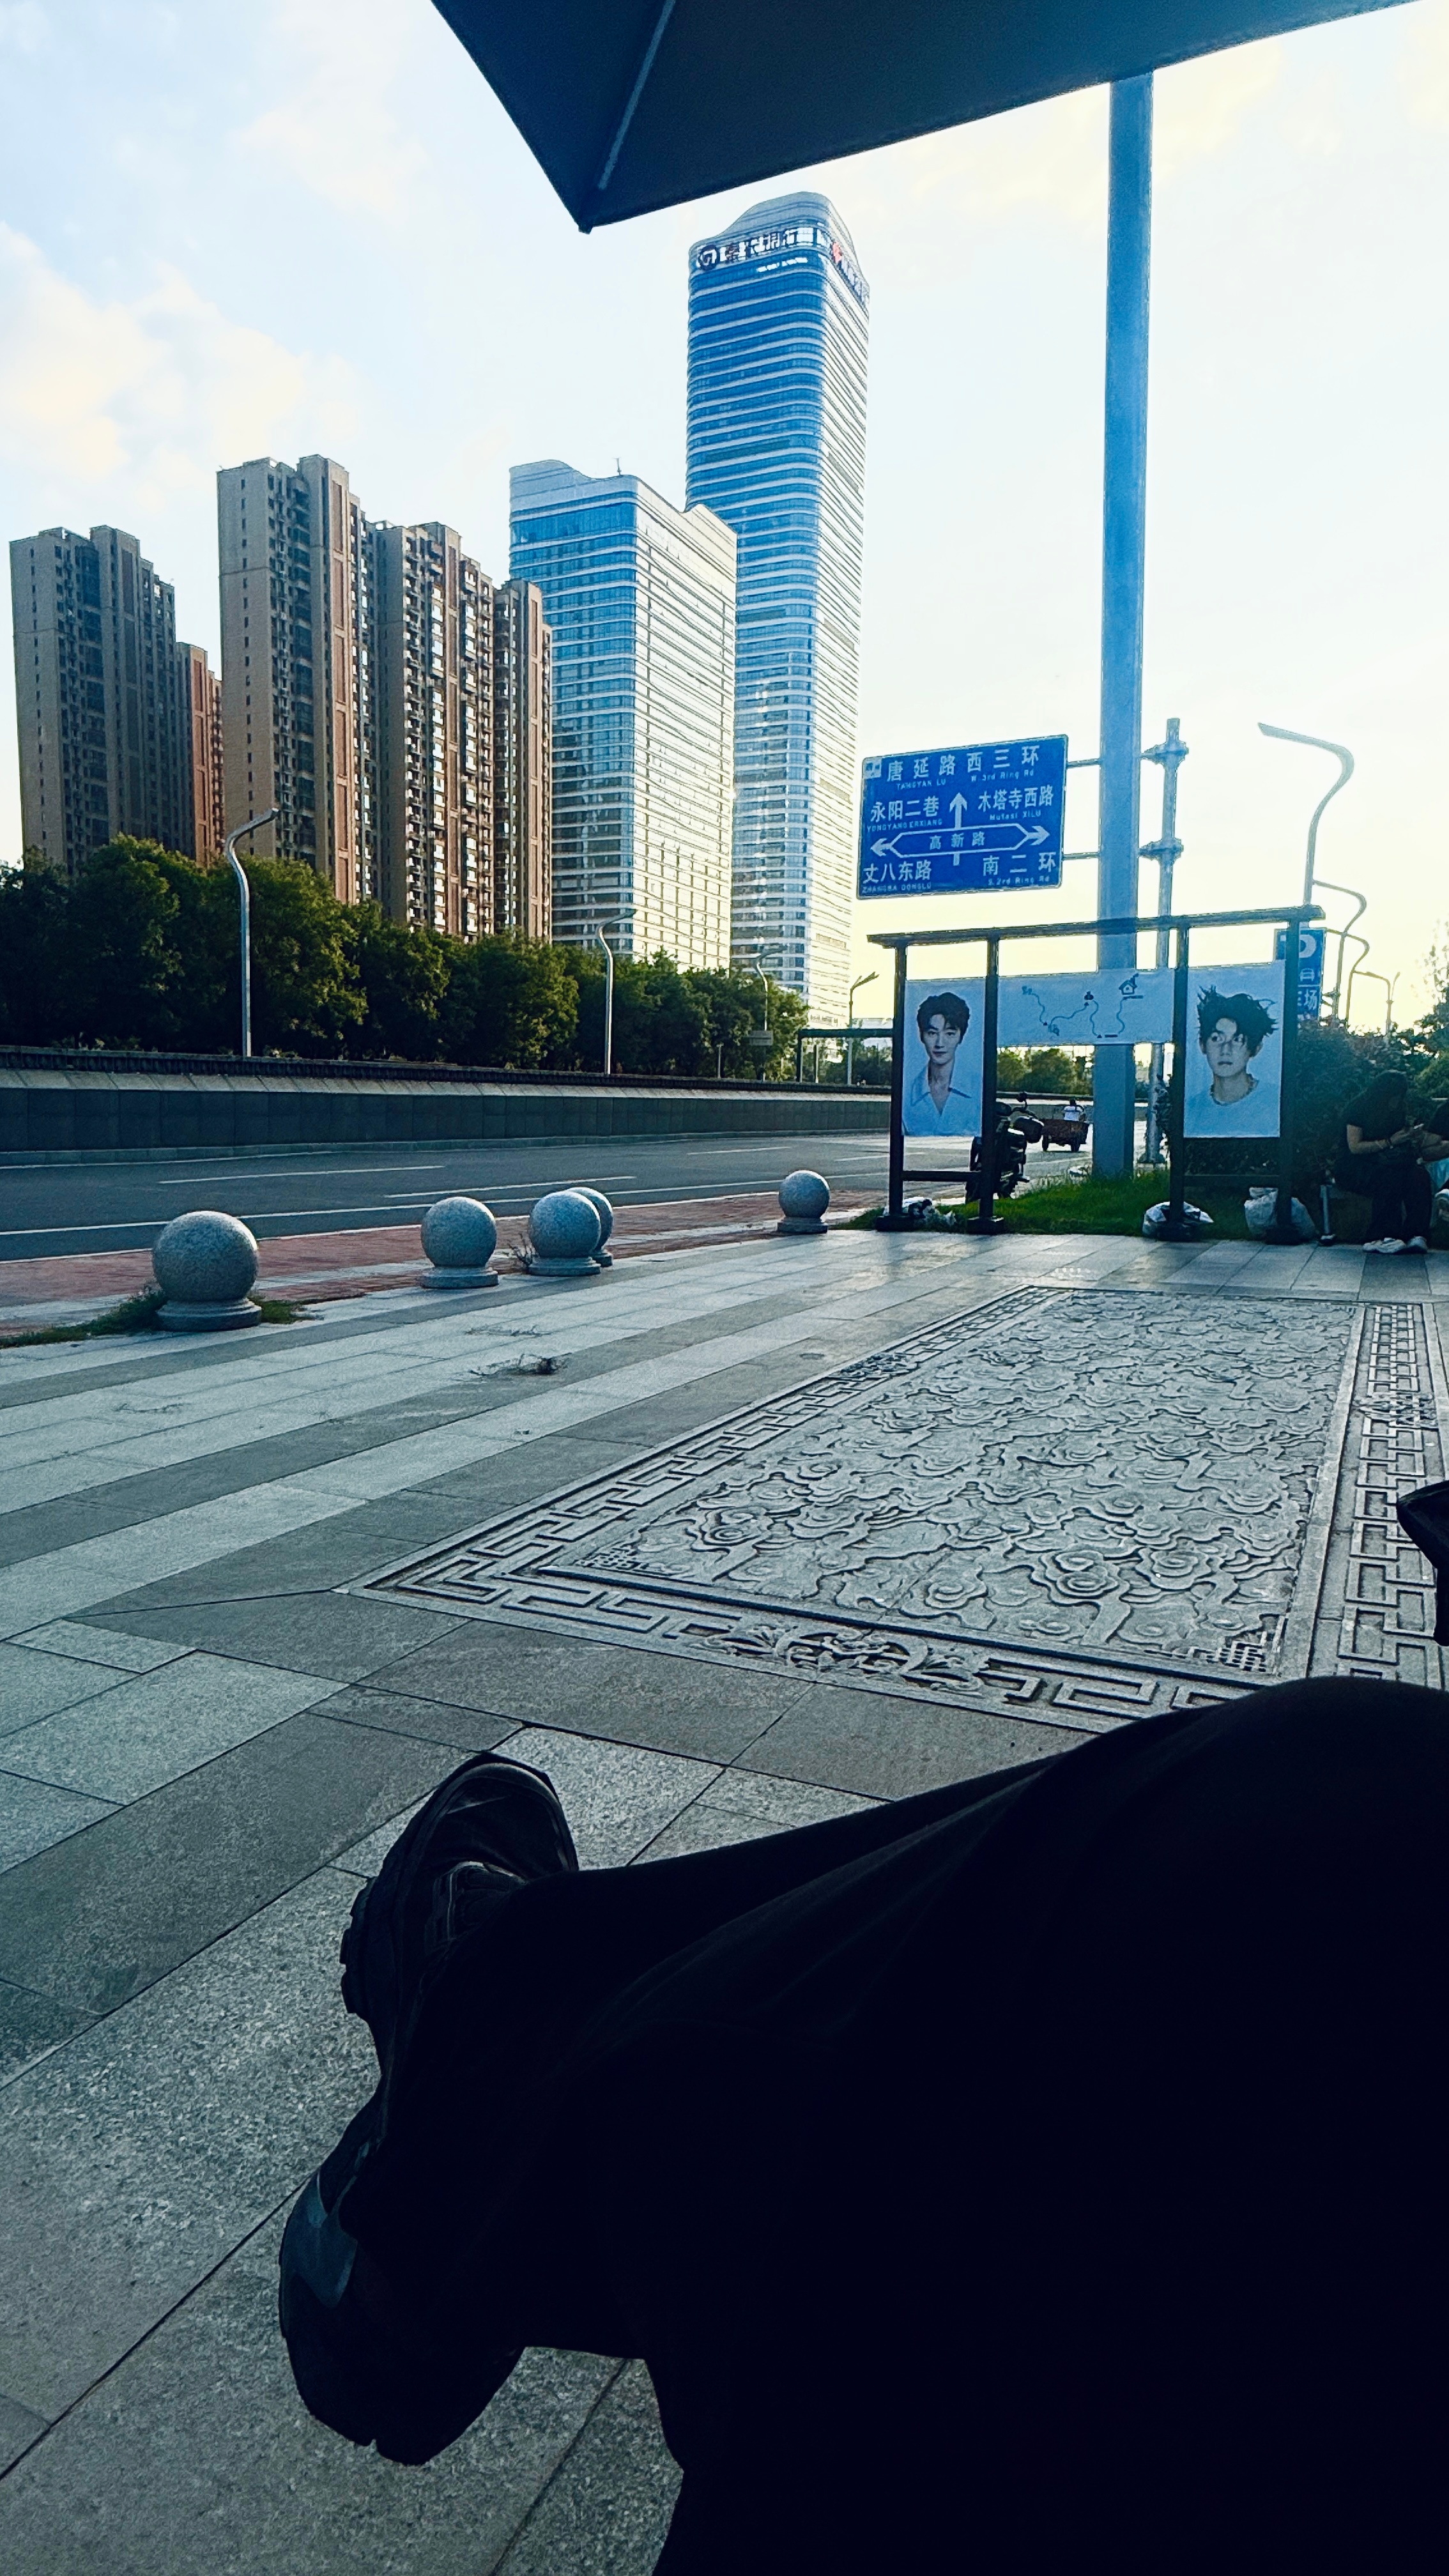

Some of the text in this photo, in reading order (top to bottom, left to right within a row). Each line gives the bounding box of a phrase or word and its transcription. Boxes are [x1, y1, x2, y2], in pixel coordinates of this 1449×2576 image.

[887, 754, 955, 783] 唐延路
[967, 745, 1040, 773] 西三环
[896, 780, 932, 790] TANGYAN
[1000, 771, 1020, 779] Ring
[1024, 769, 1034, 777] Rd
[870, 795, 939, 823] 永阳二巷
[977, 784, 1054, 813] 木塔寺西路
[929, 831, 985, 850] 高新路
[862, 859, 932, 884] 丈八东路
[983, 852, 1057, 877] 南二环
